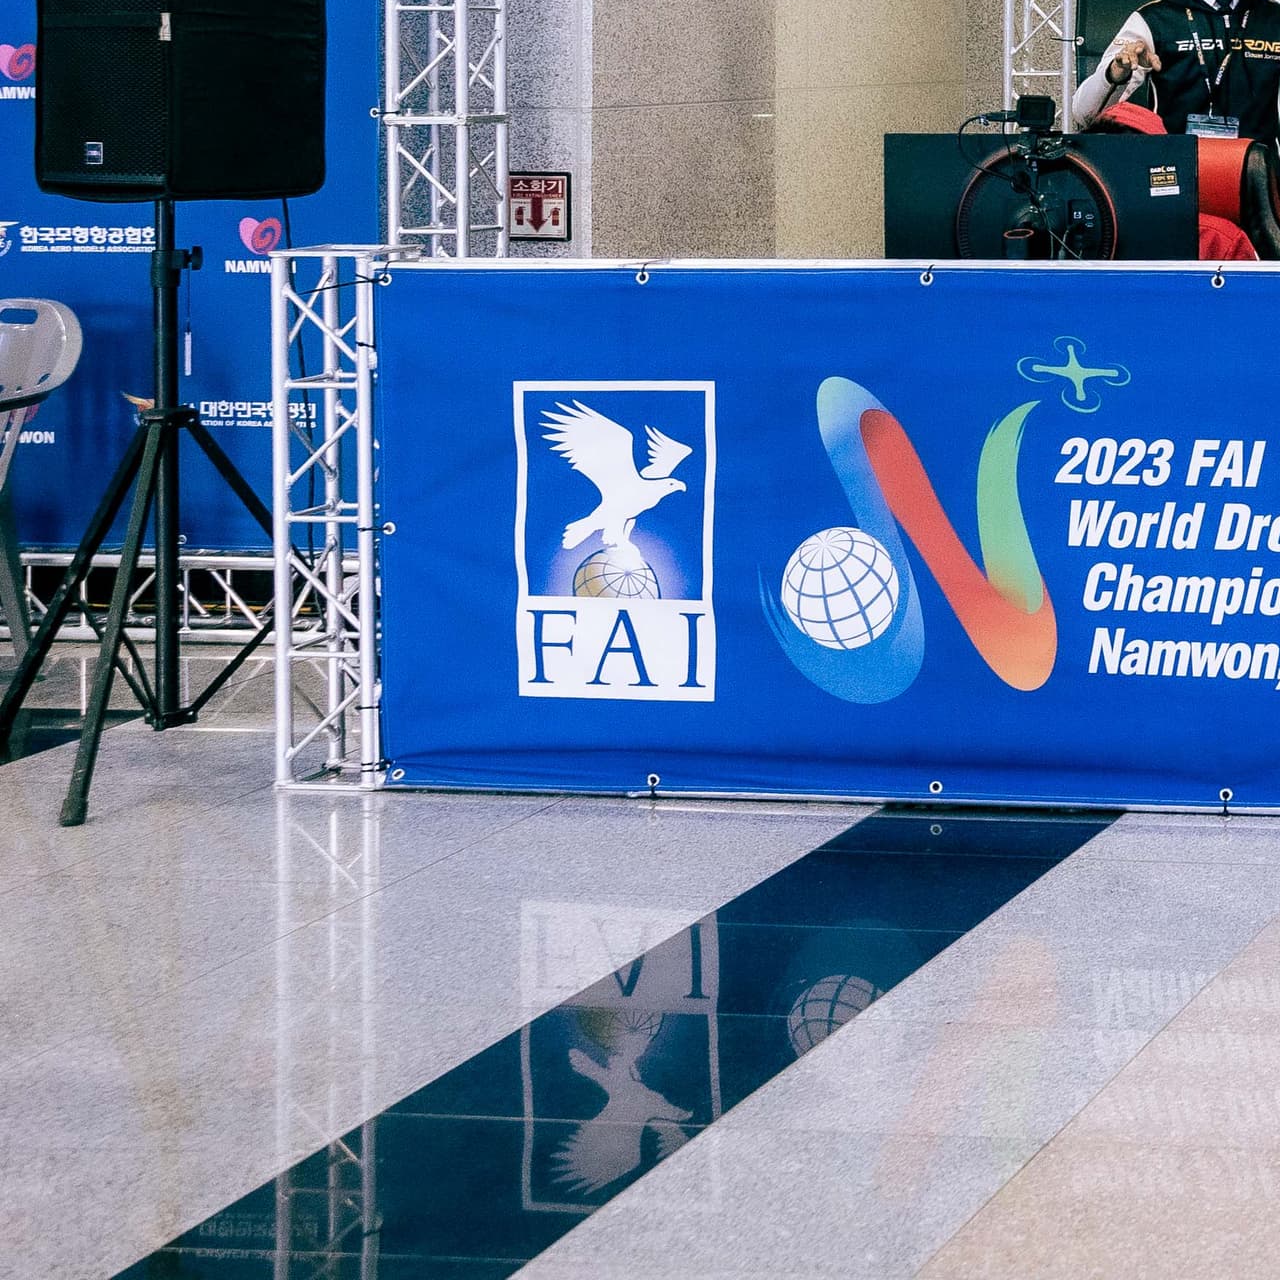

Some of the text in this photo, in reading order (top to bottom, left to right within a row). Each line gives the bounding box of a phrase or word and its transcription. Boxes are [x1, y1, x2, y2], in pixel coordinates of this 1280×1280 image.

[512, 179, 563, 193] 소화기
[1054, 437, 1266, 488] 2023 FAI
[1068, 500, 1206, 550] World
[526, 609, 707, 688] FAI
